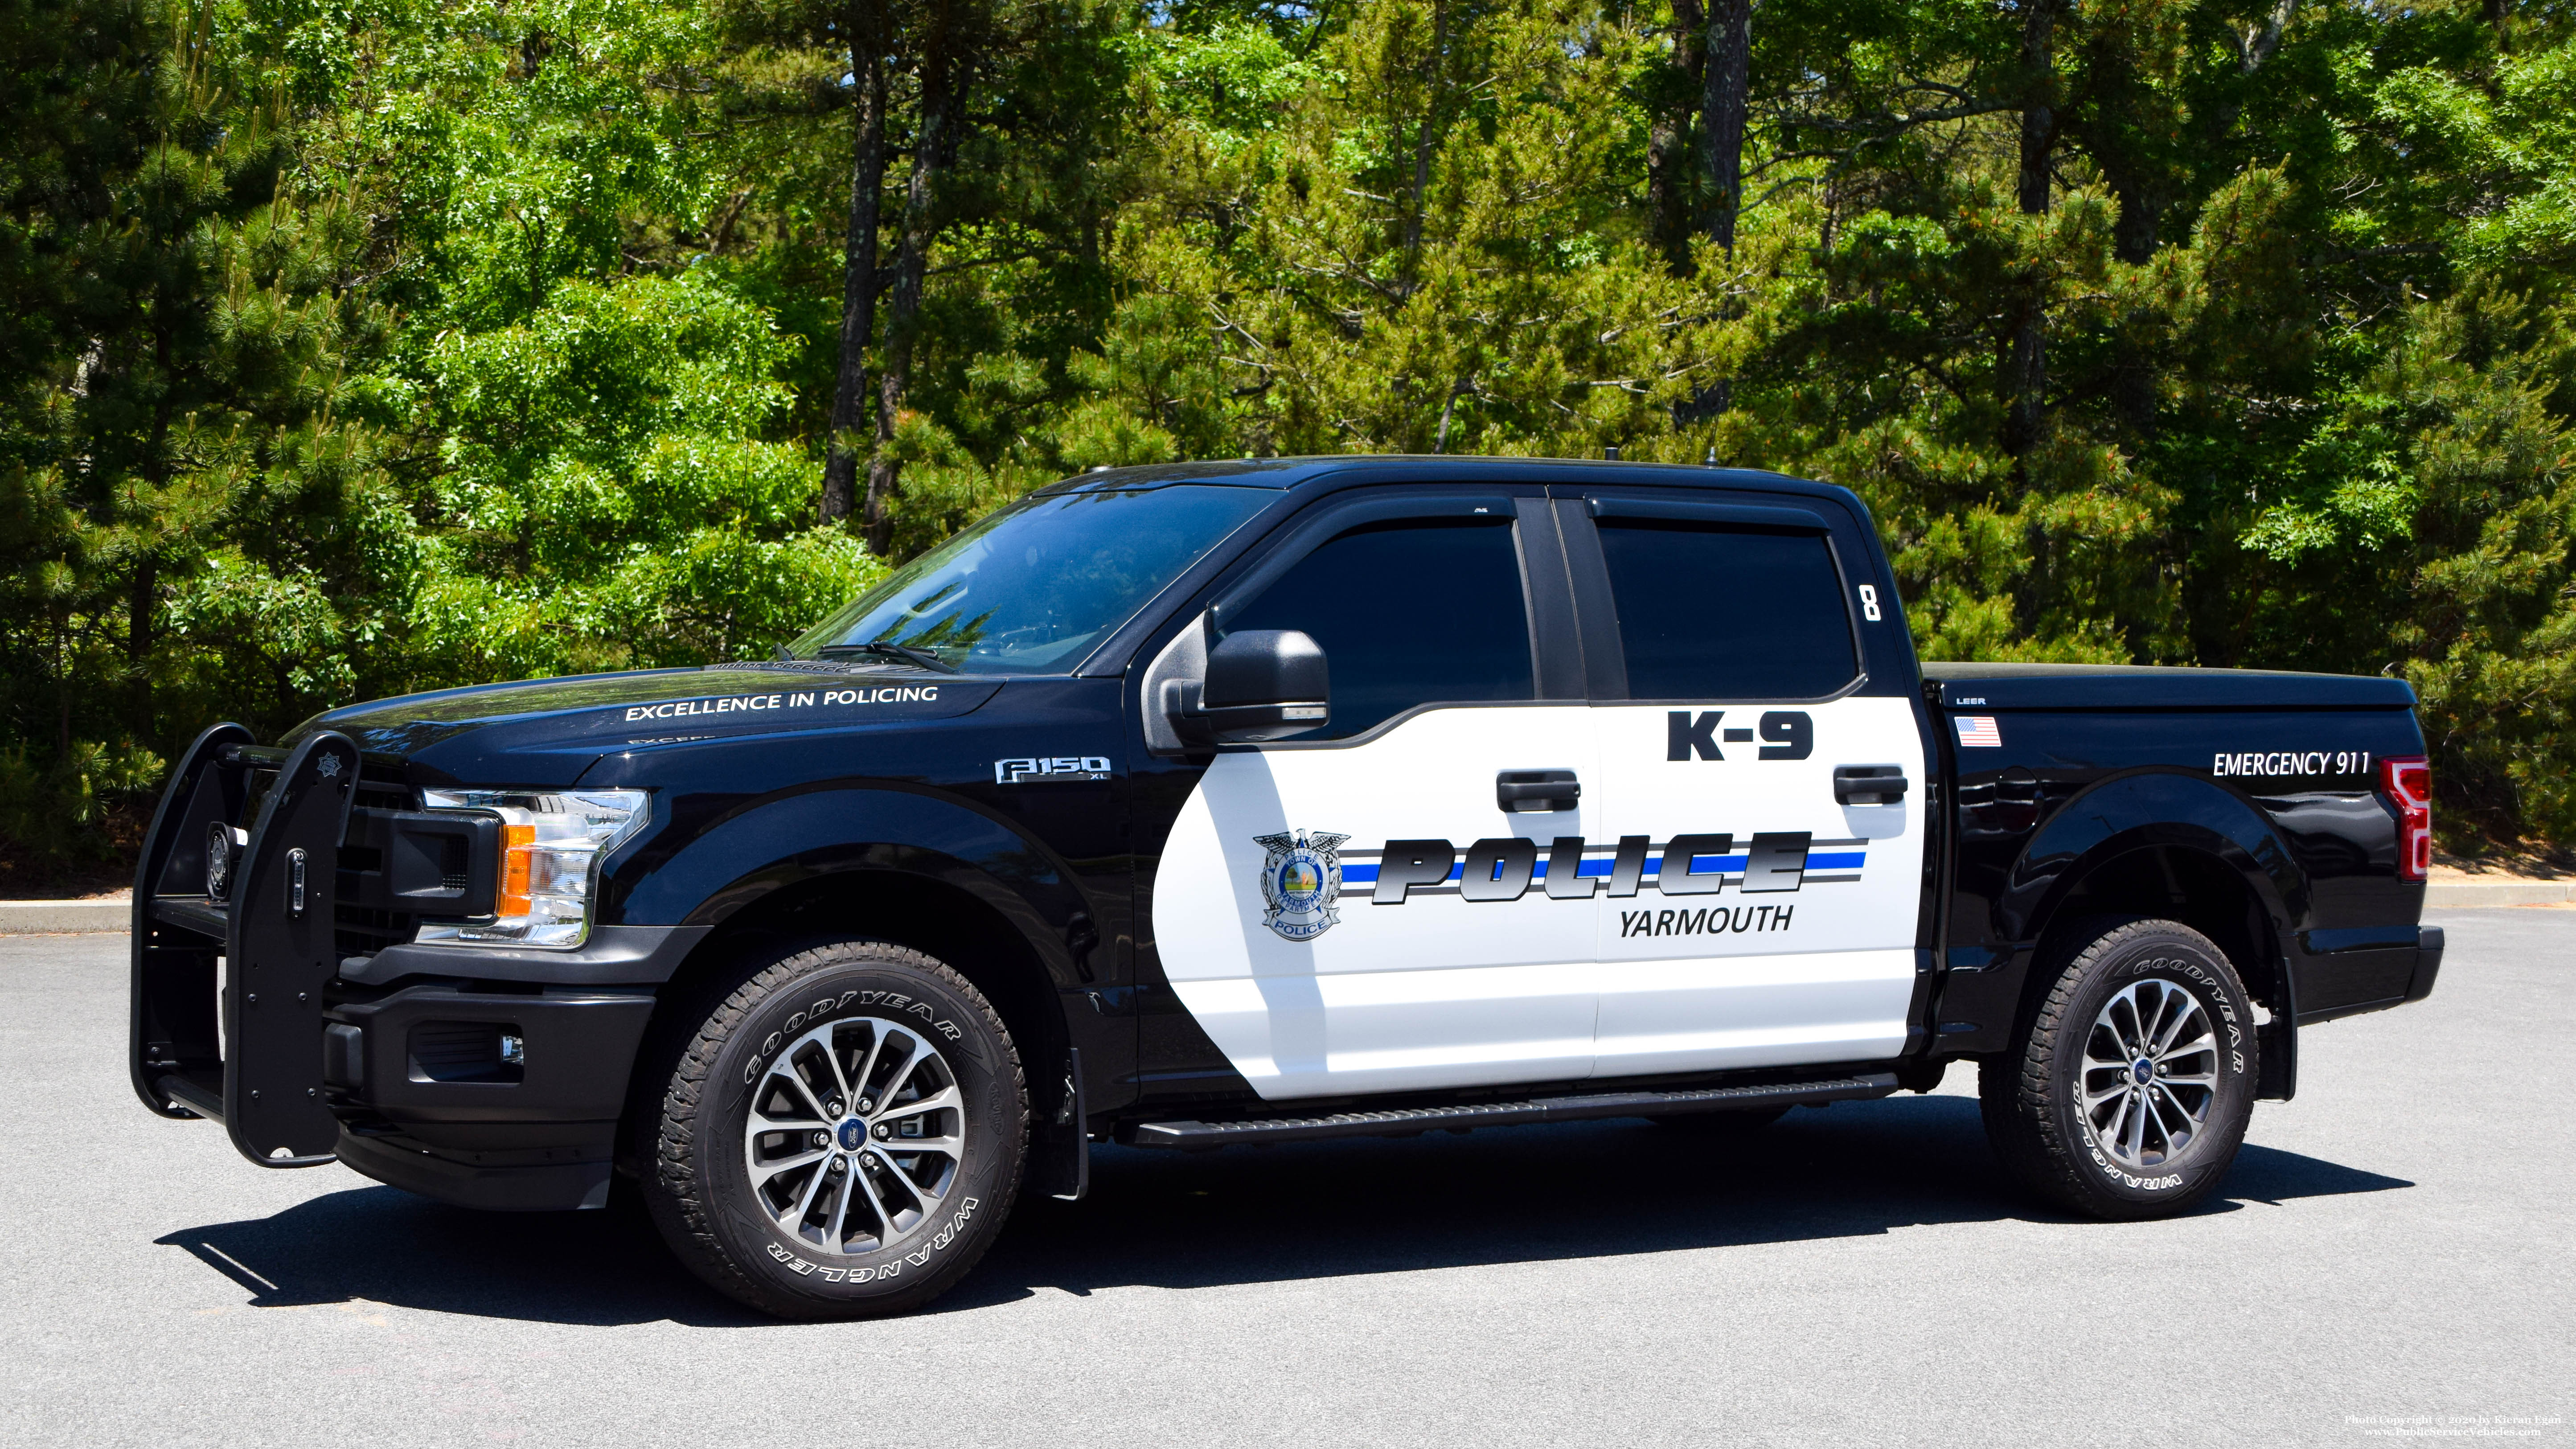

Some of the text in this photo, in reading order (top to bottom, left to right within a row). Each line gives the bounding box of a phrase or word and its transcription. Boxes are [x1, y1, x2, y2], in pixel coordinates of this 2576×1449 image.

[1859, 585, 1881, 621] 8
[625, 686, 938, 722] EXCELLENCE IN POLICING
[1667, 711, 1813, 761] K-9
[2213, 751, 2369, 776] EMERGENCY 911
[1285, 849, 1318, 860] POLICE
[1286, 857, 1317, 866] TOWN OF
[1372, 831, 1812, 905] POLICE
[1277, 892, 1324, 912] DEPARTMENT
[1281, 890, 1321, 907] YARMOUTH
[1274, 919, 1327, 935] POLICE
[1621, 904, 1794, 938] YARMOUTH
[2133, 957, 2244, 1074] GOODYEAR
[744, 990, 961, 1084] GOODYEAR
[2072, 1081, 2182, 1190] WRANGLER
[767, 1197, 979, 1284] WRANGLER
